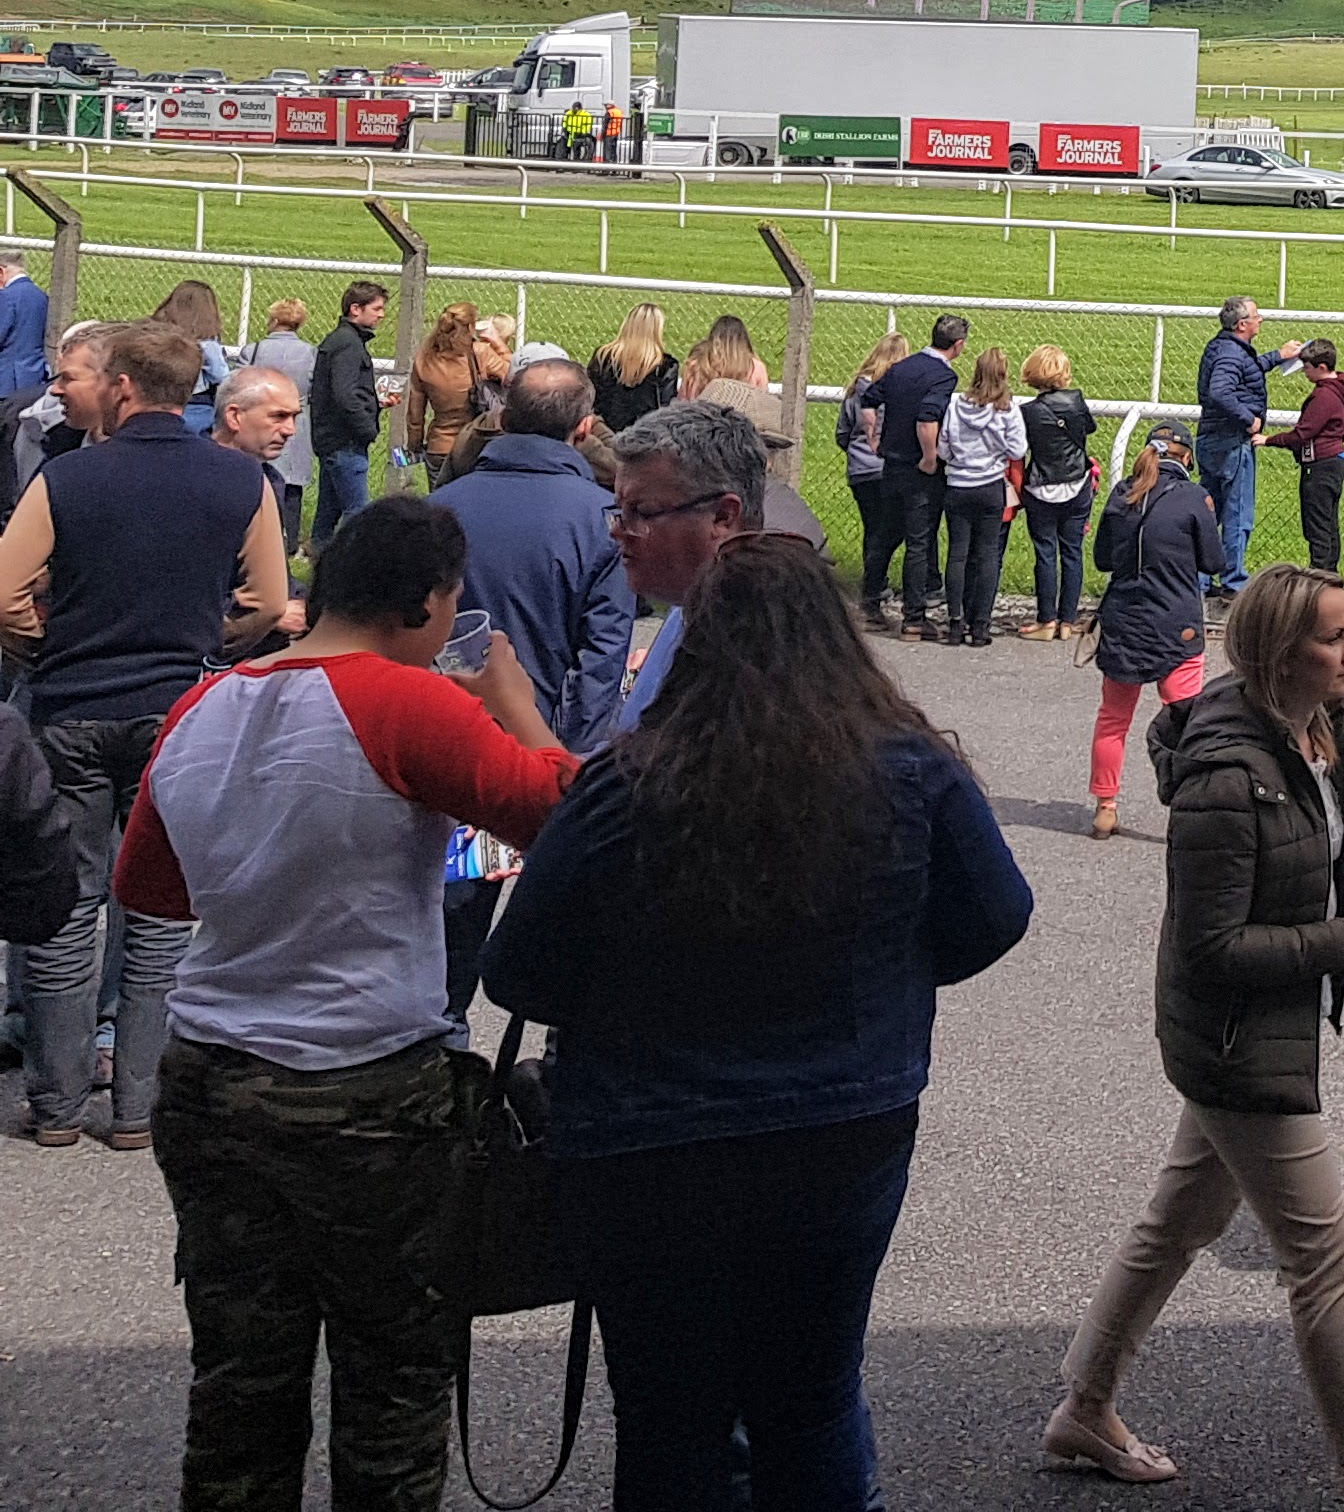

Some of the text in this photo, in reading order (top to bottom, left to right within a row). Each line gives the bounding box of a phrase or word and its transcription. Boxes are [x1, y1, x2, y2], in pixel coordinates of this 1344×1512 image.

[240, 101, 266, 111] Midland
[287, 110, 327, 122] FARMERS
[357, 112, 398, 124] FARMERS
[286, 122, 327, 133] JOURNAL
[357, 124, 400, 136] JOURNAL
[836, 132, 872, 141] STALLION
[873, 133, 899, 141] FARMS
[928, 132, 992, 147] FARMERS
[1056, 137, 1122, 152] FARMERS
[927, 144, 993, 160] JOURNAL
[1056, 150, 1123, 165] JOURNAL
